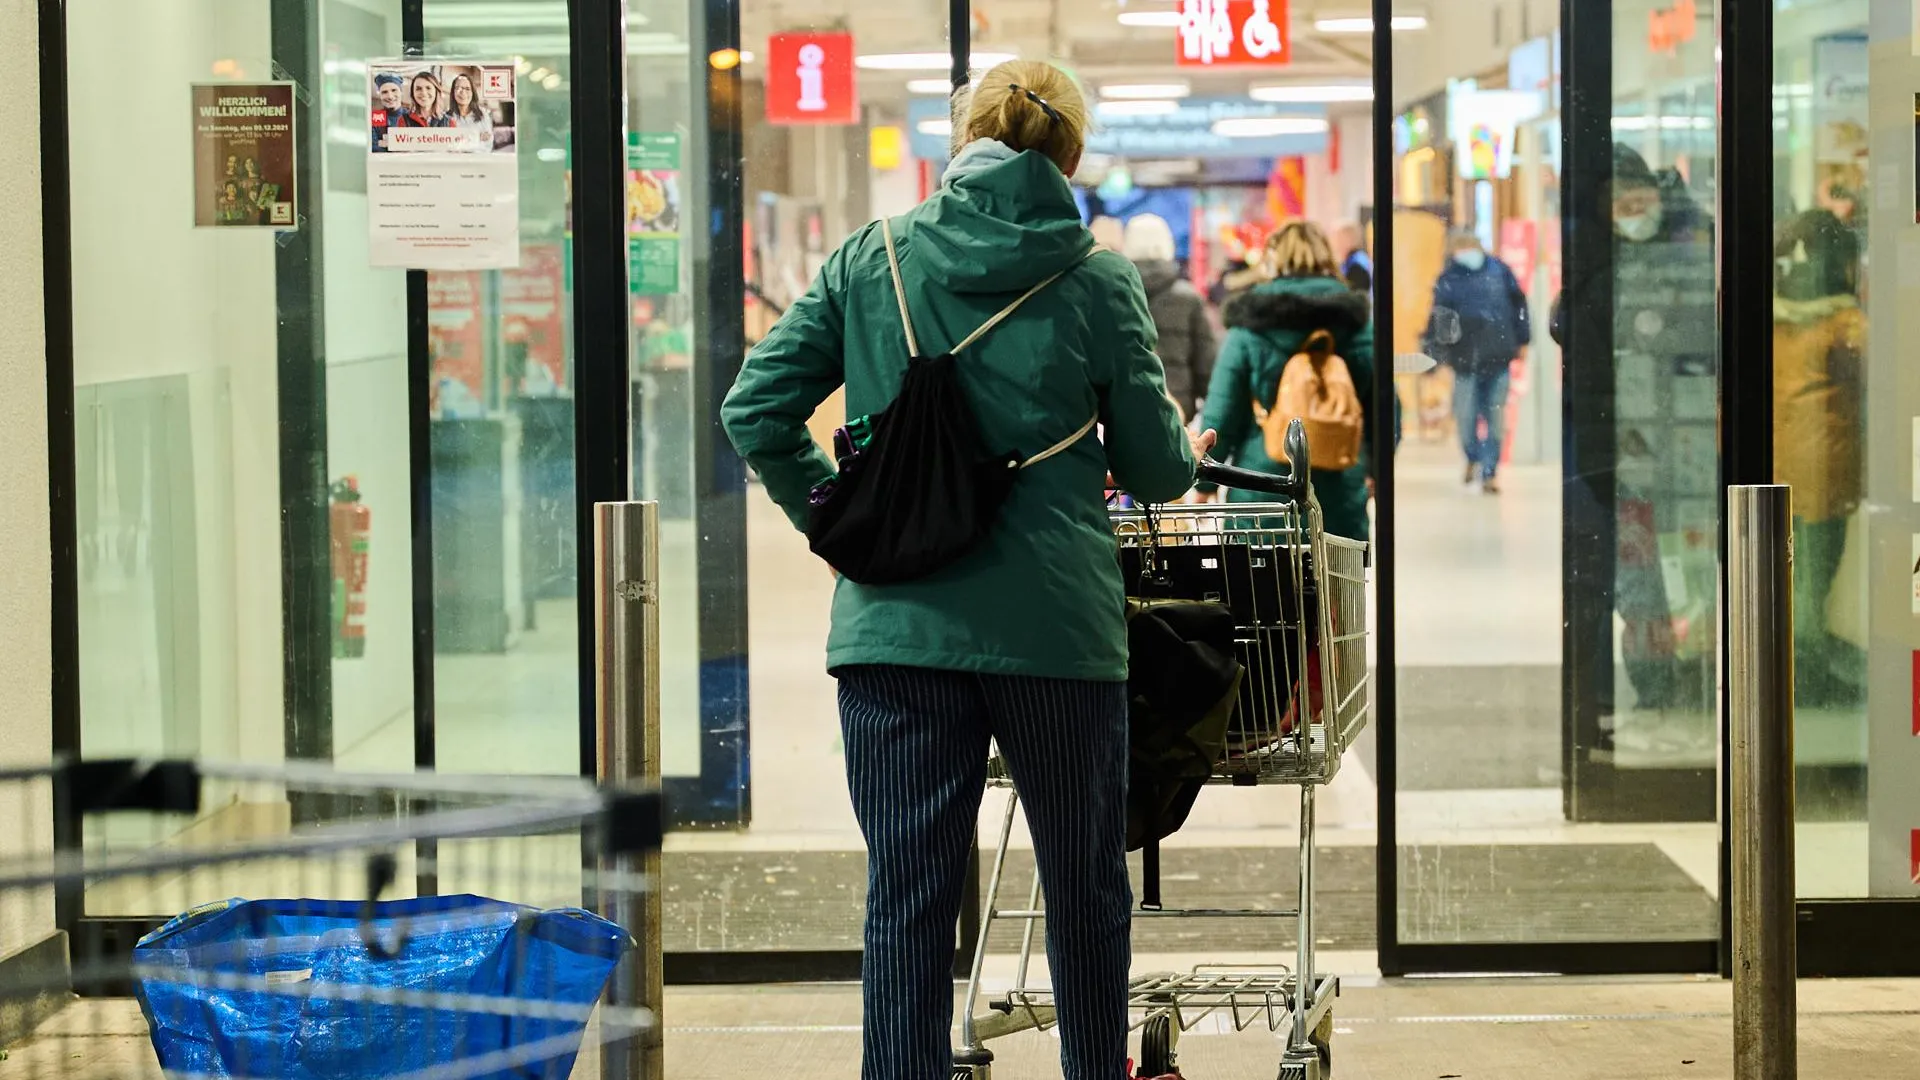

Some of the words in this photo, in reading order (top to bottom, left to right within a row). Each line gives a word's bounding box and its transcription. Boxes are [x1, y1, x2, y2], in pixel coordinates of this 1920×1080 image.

[219, 97, 267, 106] HERZLICH
[200, 105, 287, 117] WILLKOMMEN!
[395, 134, 415, 144] Wir
[416, 134, 452, 144] stellen
